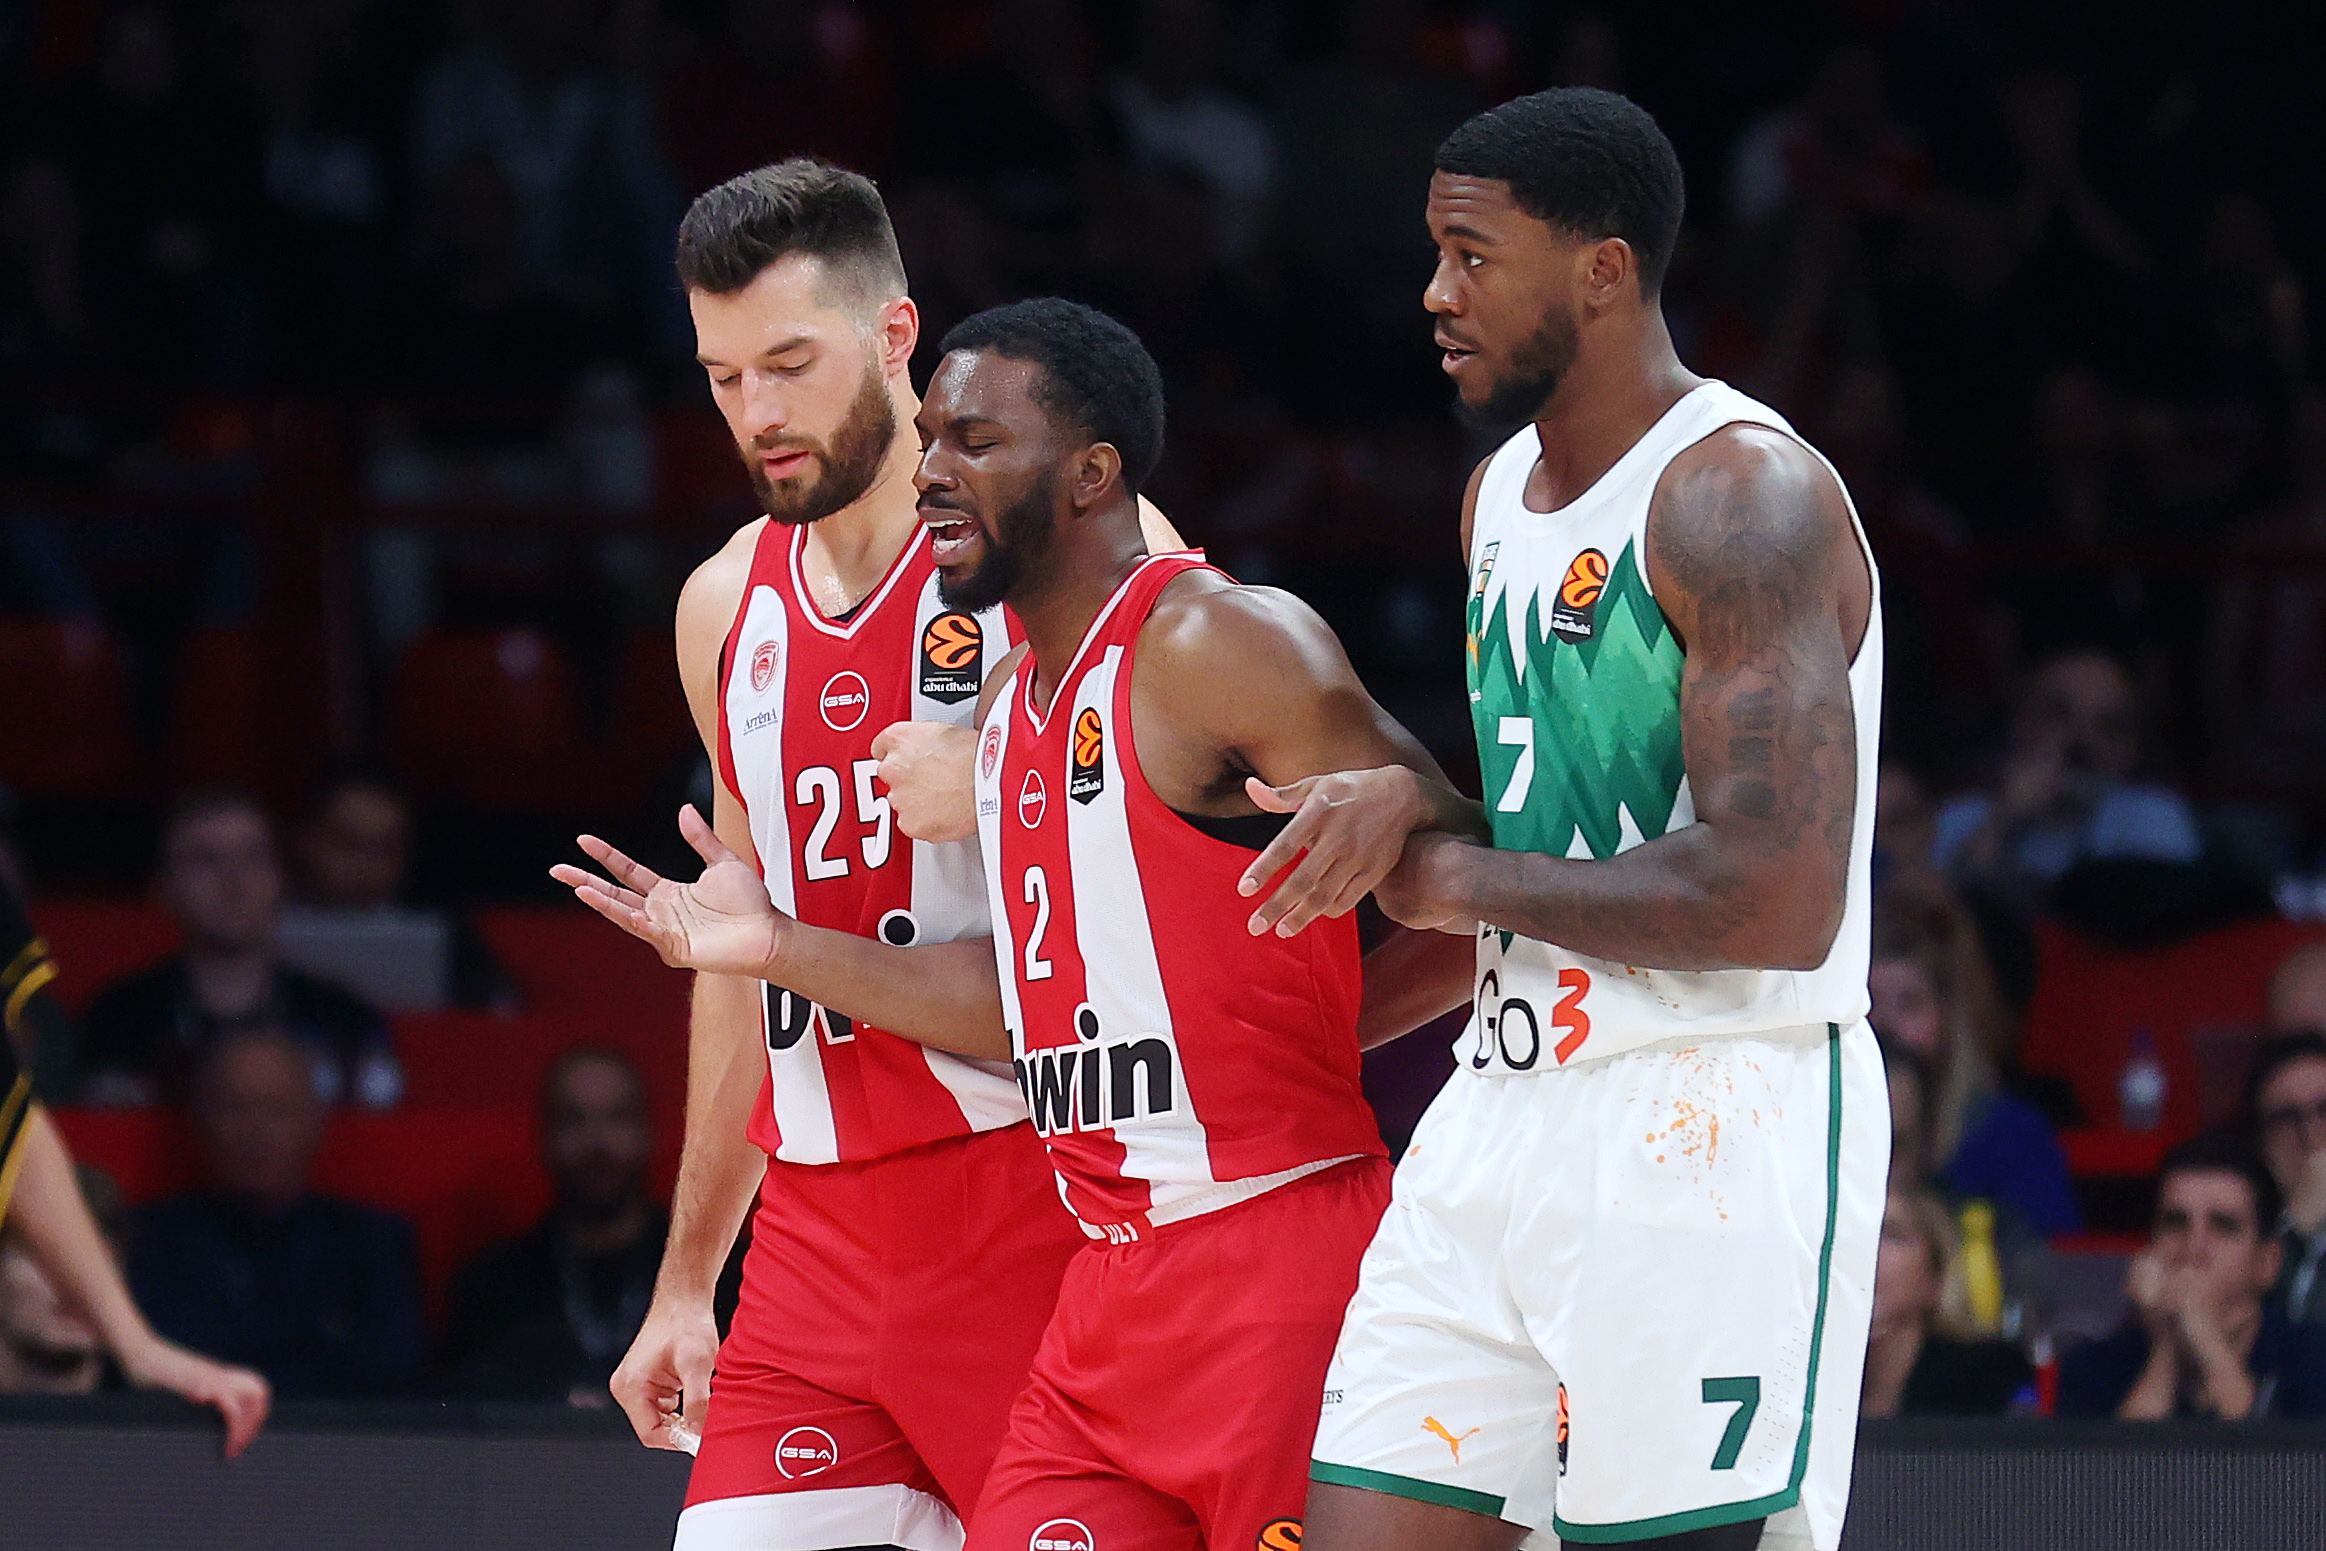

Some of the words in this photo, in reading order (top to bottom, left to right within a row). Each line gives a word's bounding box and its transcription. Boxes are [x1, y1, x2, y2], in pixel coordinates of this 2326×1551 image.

[824, 693, 865, 707] GSA
[923, 682, 945, 692] abu
[945, 681, 978, 692] dhabi
[1496, 716, 1535, 813] 7
[796, 759, 892, 882] 25
[1024, 866, 1052, 981] 2
[1702, 1376, 1760, 1470] 7
[781, 1447, 832, 1460] GSA
[1035, 1539, 1088, 1551] GSA
